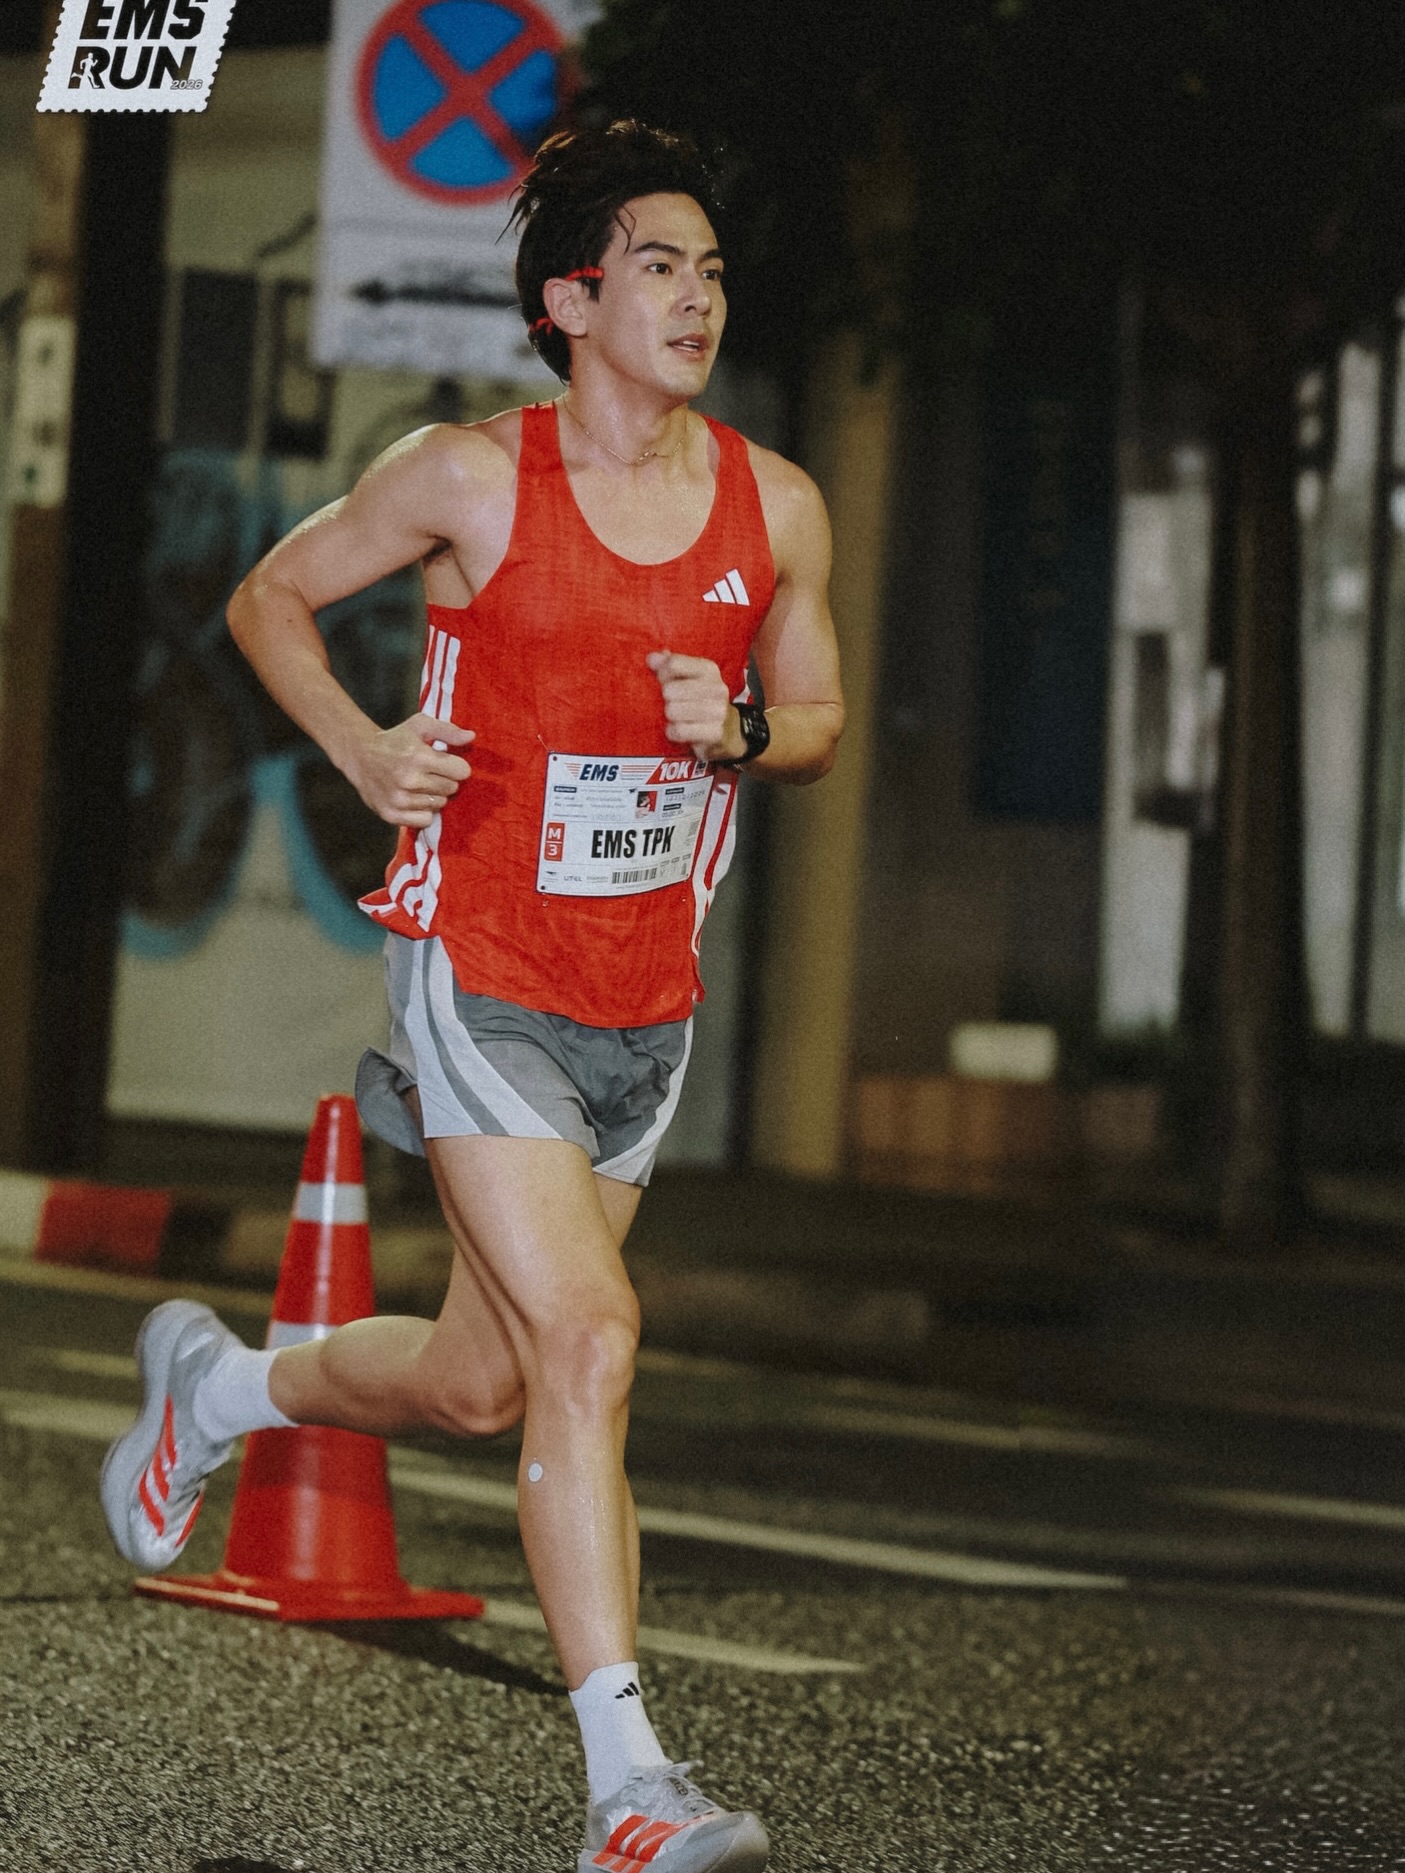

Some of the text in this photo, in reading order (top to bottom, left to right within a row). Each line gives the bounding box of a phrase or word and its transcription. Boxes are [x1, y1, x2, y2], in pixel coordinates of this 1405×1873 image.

[579, 763, 620, 782] EMS
[659, 760, 693, 781] 10K
[547, 827, 562, 840] M
[591, 825, 676, 859] EMS TPK
[547, 844, 558, 856] 3
